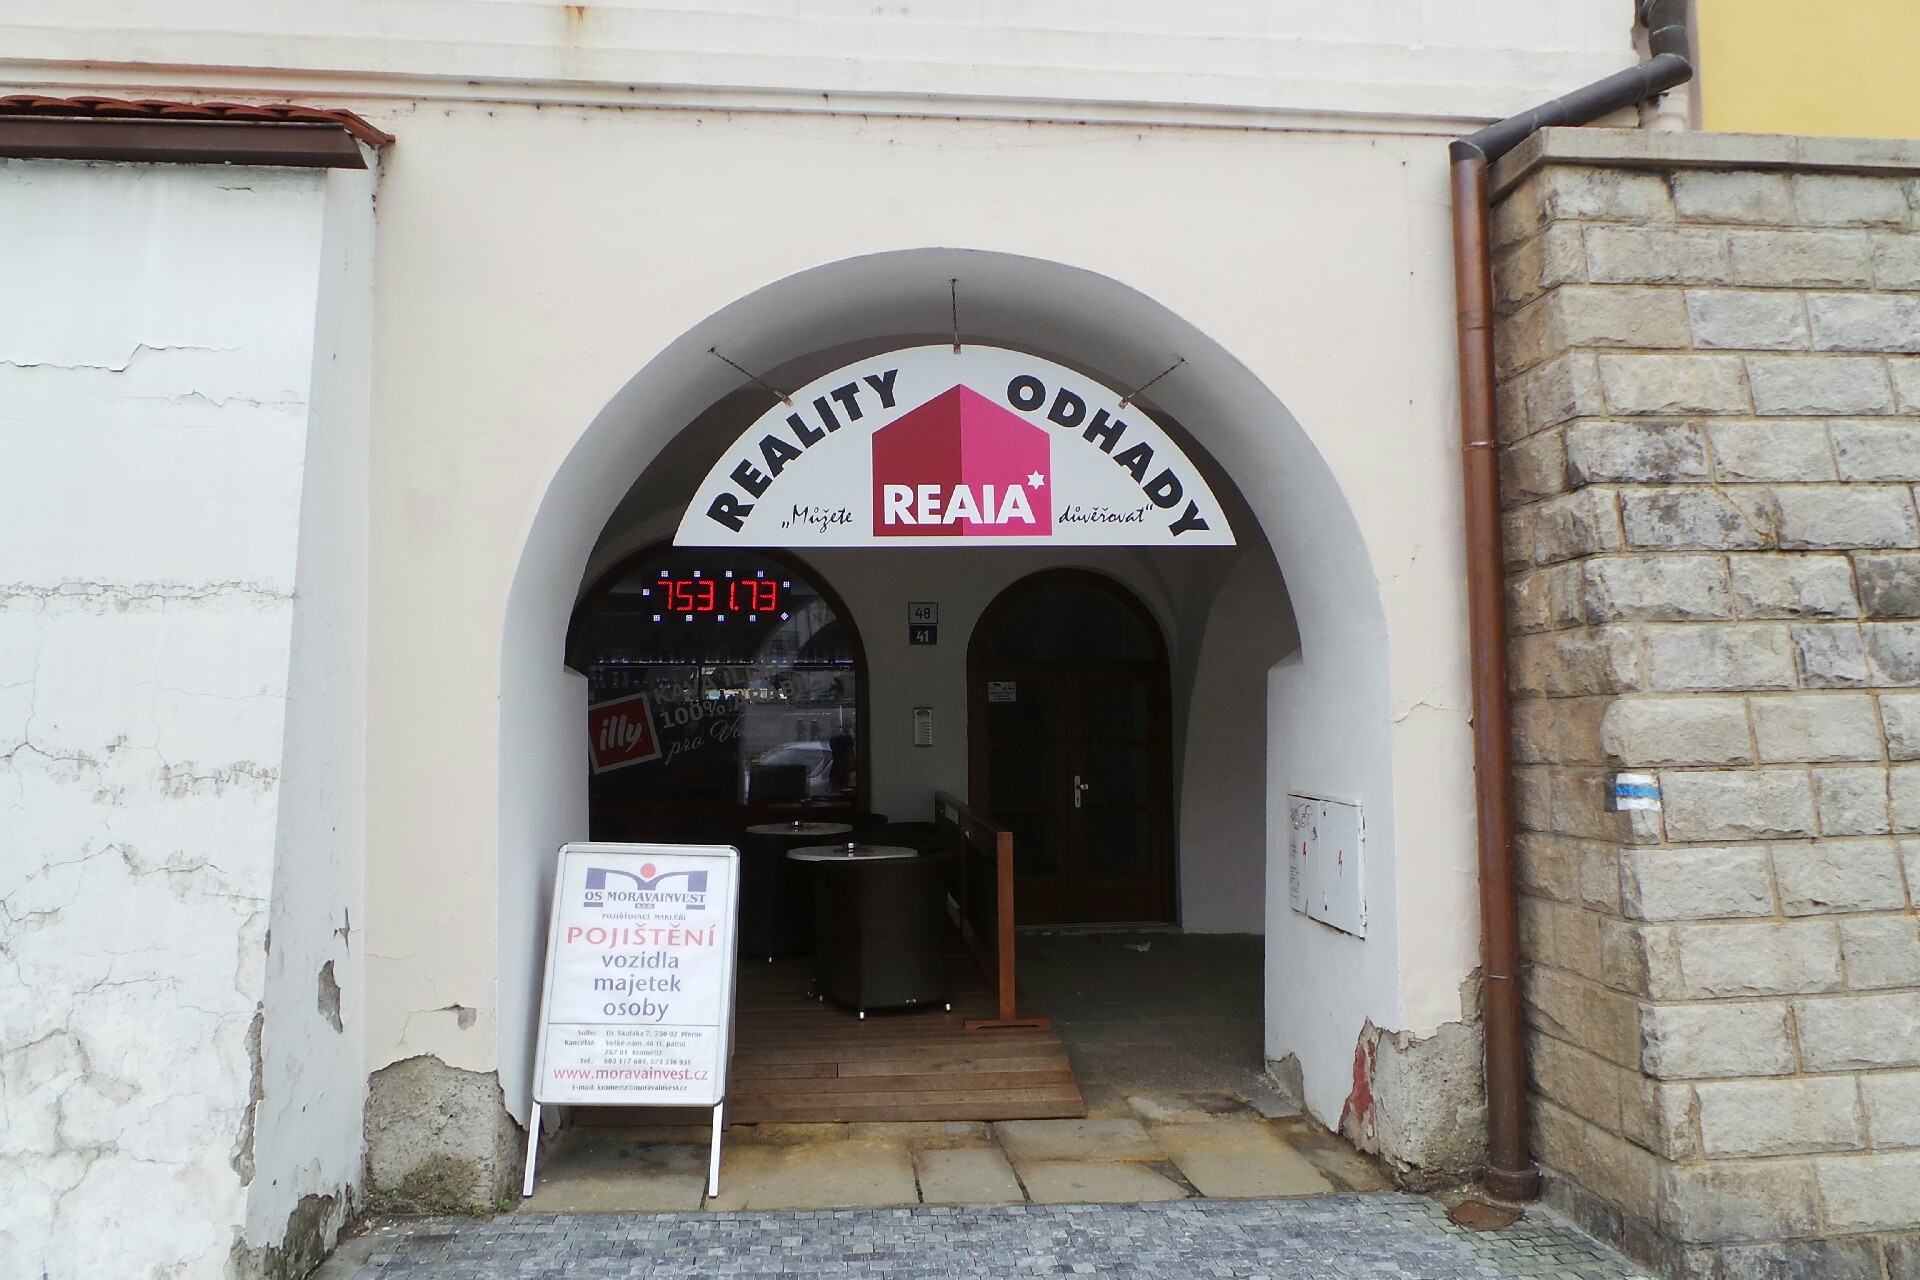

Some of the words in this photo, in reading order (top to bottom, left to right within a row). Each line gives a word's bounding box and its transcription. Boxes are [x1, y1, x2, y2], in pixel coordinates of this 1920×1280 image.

[706, 368, 898, 532] REALITY
[1007, 374, 1210, 537] ODHADY
[915, 607, 931, 619] 48
[916, 630, 929, 643] 41
[660, 698, 726, 728] 100%
[600, 714, 643, 753] illy
[665, 737, 705, 766] pro
[584, 891, 603, 902] OS
[606, 891, 707, 903] MORAVAINVEST
[567, 922, 716, 949] POJIŠTĚNÍ
[602, 950, 679, 969] vozidla
[593, 973, 682, 997] majetek
[603, 997, 669, 1022] osoby
[554, 1067, 709, 1082] www.moravainvest.cz
